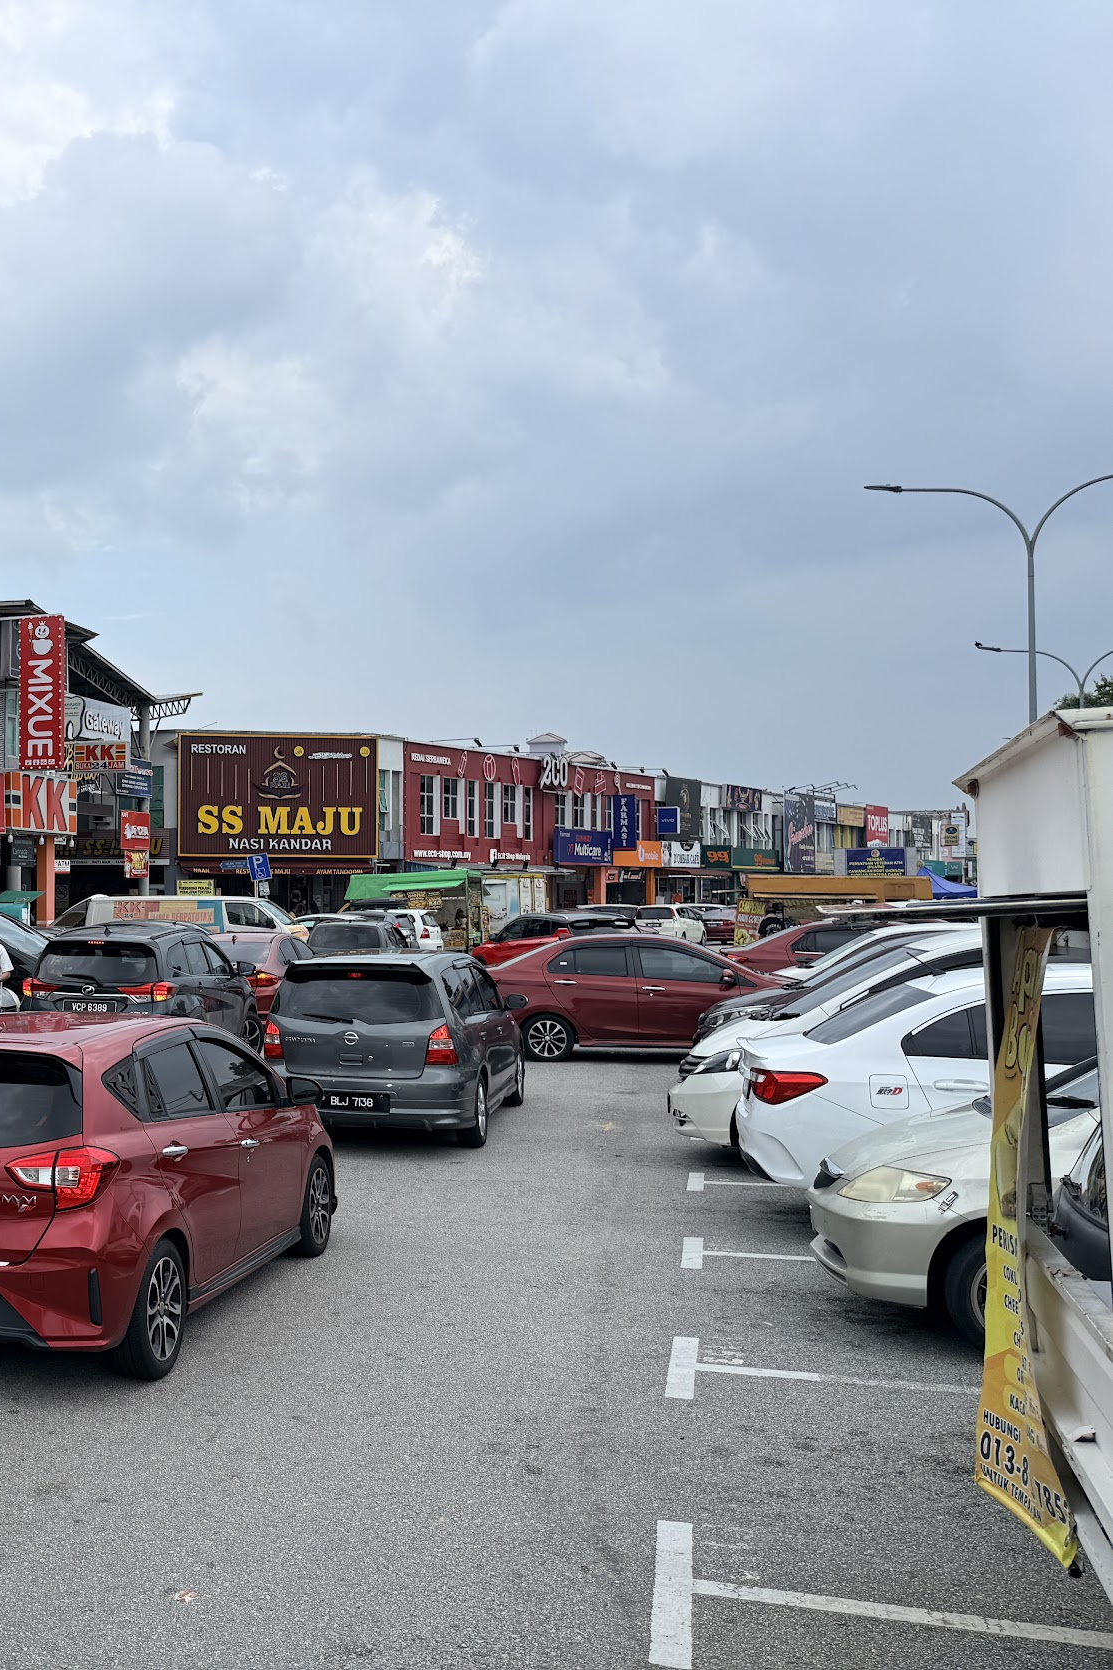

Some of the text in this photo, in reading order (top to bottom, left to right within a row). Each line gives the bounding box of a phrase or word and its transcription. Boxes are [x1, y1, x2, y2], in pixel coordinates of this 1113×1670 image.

[28, 659, 53, 757] MIXUE
[85, 711, 124, 740] Gateway
[86, 745, 115, 761] KK
[191, 744, 247, 754] RESTORAN
[76, 762, 91, 770] BUKA
[91, 762, 108, 770] 24
[22, 774, 68, 833] KK
[197, 805, 363, 835] SS MAJU
[619, 798, 628, 847] FARMASI
[83, 838, 106, 856] SS
[229, 838, 332, 850] NASI KANDAR
[574, 843, 602, 857] Multicare
[252, 856, 263, 869] P
[413, 849, 472, 862] www.eco-shop.com.my
[707, 851, 730, 863] 99
[72, 1002, 108, 1012] VCP 6389
[331, 1096, 374, 1107] BLJ 7138
[983, 1409, 1021, 1444] HUBUNGI
[980, 1463, 1009, 1492] UNTUK
